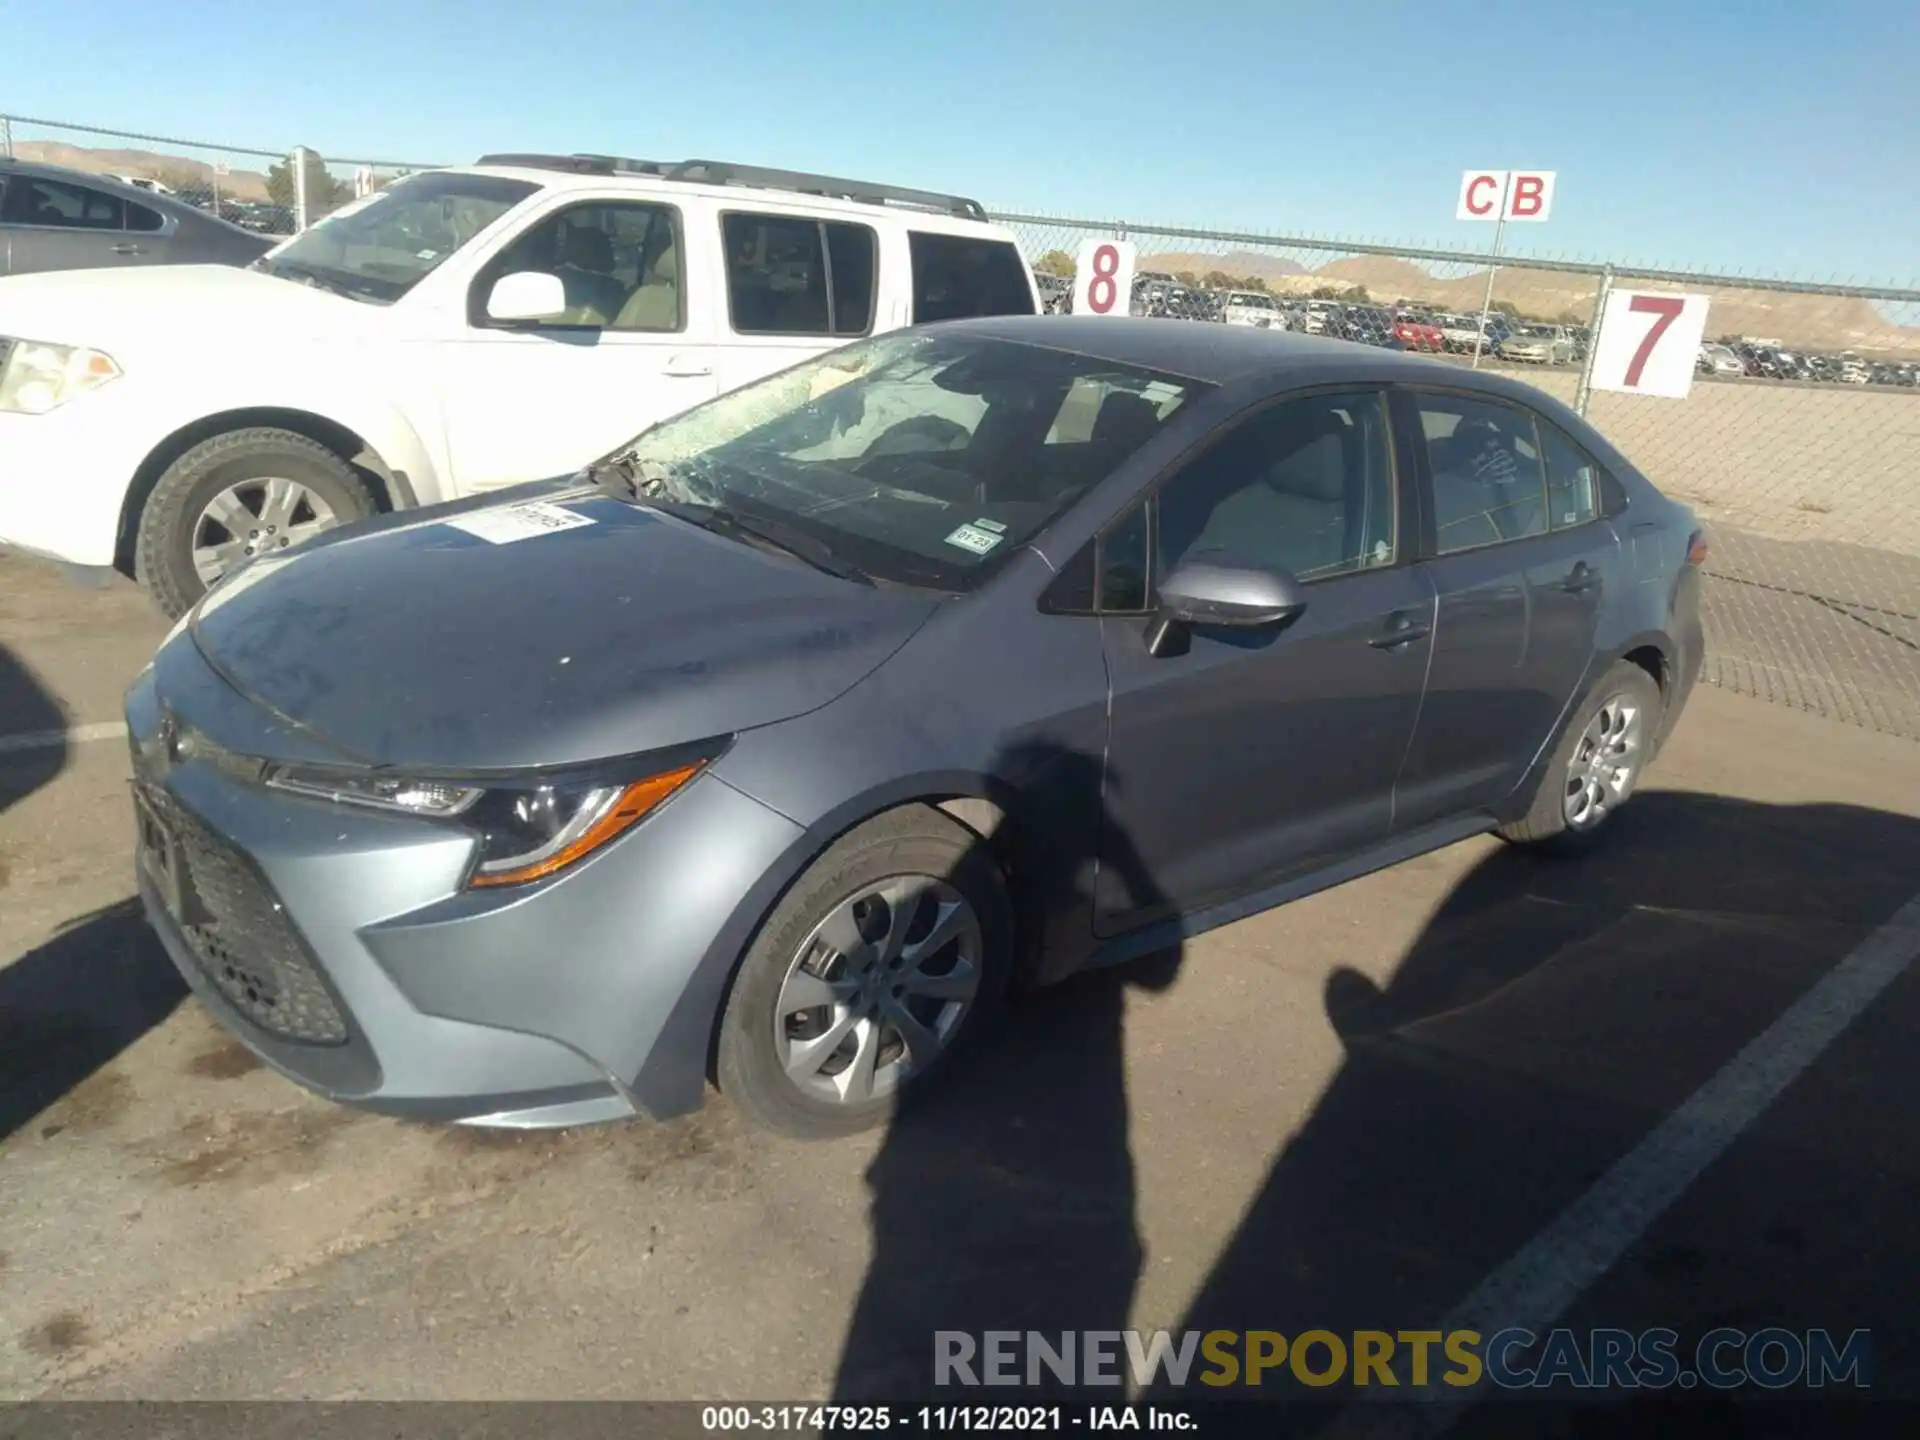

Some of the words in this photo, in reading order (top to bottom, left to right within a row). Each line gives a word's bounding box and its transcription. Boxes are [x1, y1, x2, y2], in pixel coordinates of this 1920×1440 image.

[1466, 175, 1497, 215] C
[1511, 176, 1544, 215] B
[1088, 244, 1119, 314] 8
[1623, 295, 1685, 387] 7
